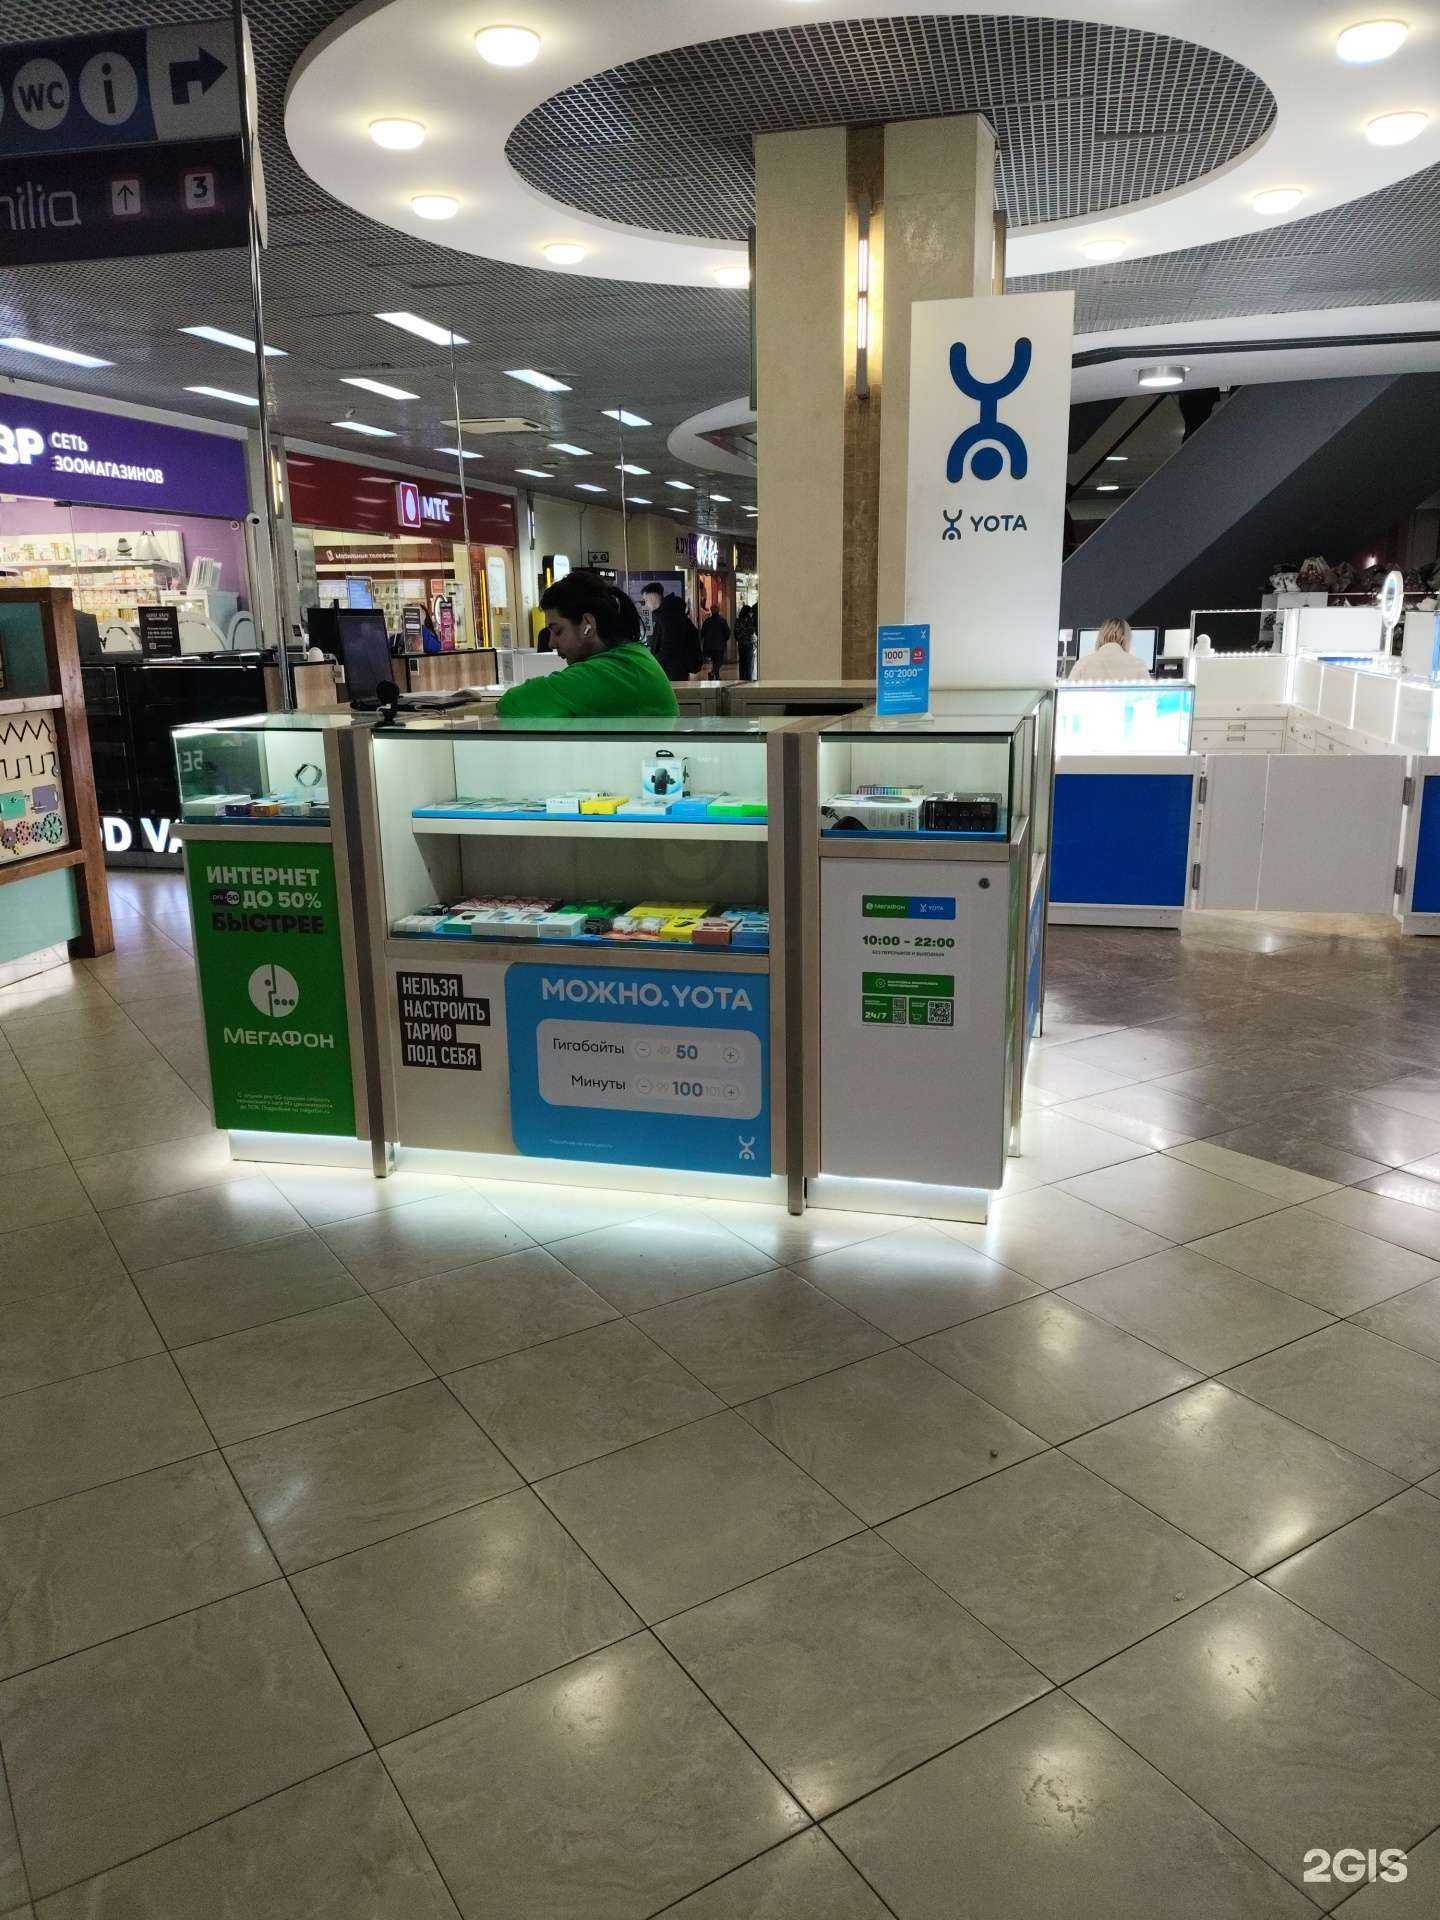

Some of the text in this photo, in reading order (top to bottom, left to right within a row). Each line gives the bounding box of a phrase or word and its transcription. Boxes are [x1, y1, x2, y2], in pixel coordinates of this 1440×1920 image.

[18, 81, 65, 113] WC
[192, 176, 208, 198] 3
[51, 432, 88, 452] СЕТЬ
[53, 455, 164, 484] ЗООМАГАЗИНОВ
[421, 495, 450, 522] МТС
[970, 515, 1027, 532] YOTA
[99, 817, 132, 852] D
[206, 866, 319, 887] ИНТЕРНЕТ
[242, 890, 273, 909] ДО
[278, 891, 322, 909] 50%
[212, 912, 324, 934] БЫСТРЕЕ
[862, 935, 900, 946] 10:00
[914, 937, 955, 948] 22:00
[402, 976, 459, 997] НЕЛЬЗЯ
[404, 999, 486, 1021] НАСТРОИТЬ
[864, 1011, 888, 1020] 24/7
[405, 1022, 452, 1042] ТАРИФ
[407, 1044, 477, 1066] ПОД СЕБЯ
[552, 1037, 625, 1055] Гигабайты
[675, 1044, 699, 1060] 50
[571, 1074, 627, 1092] Минуты
[672, 1081, 704, 1098] 100
